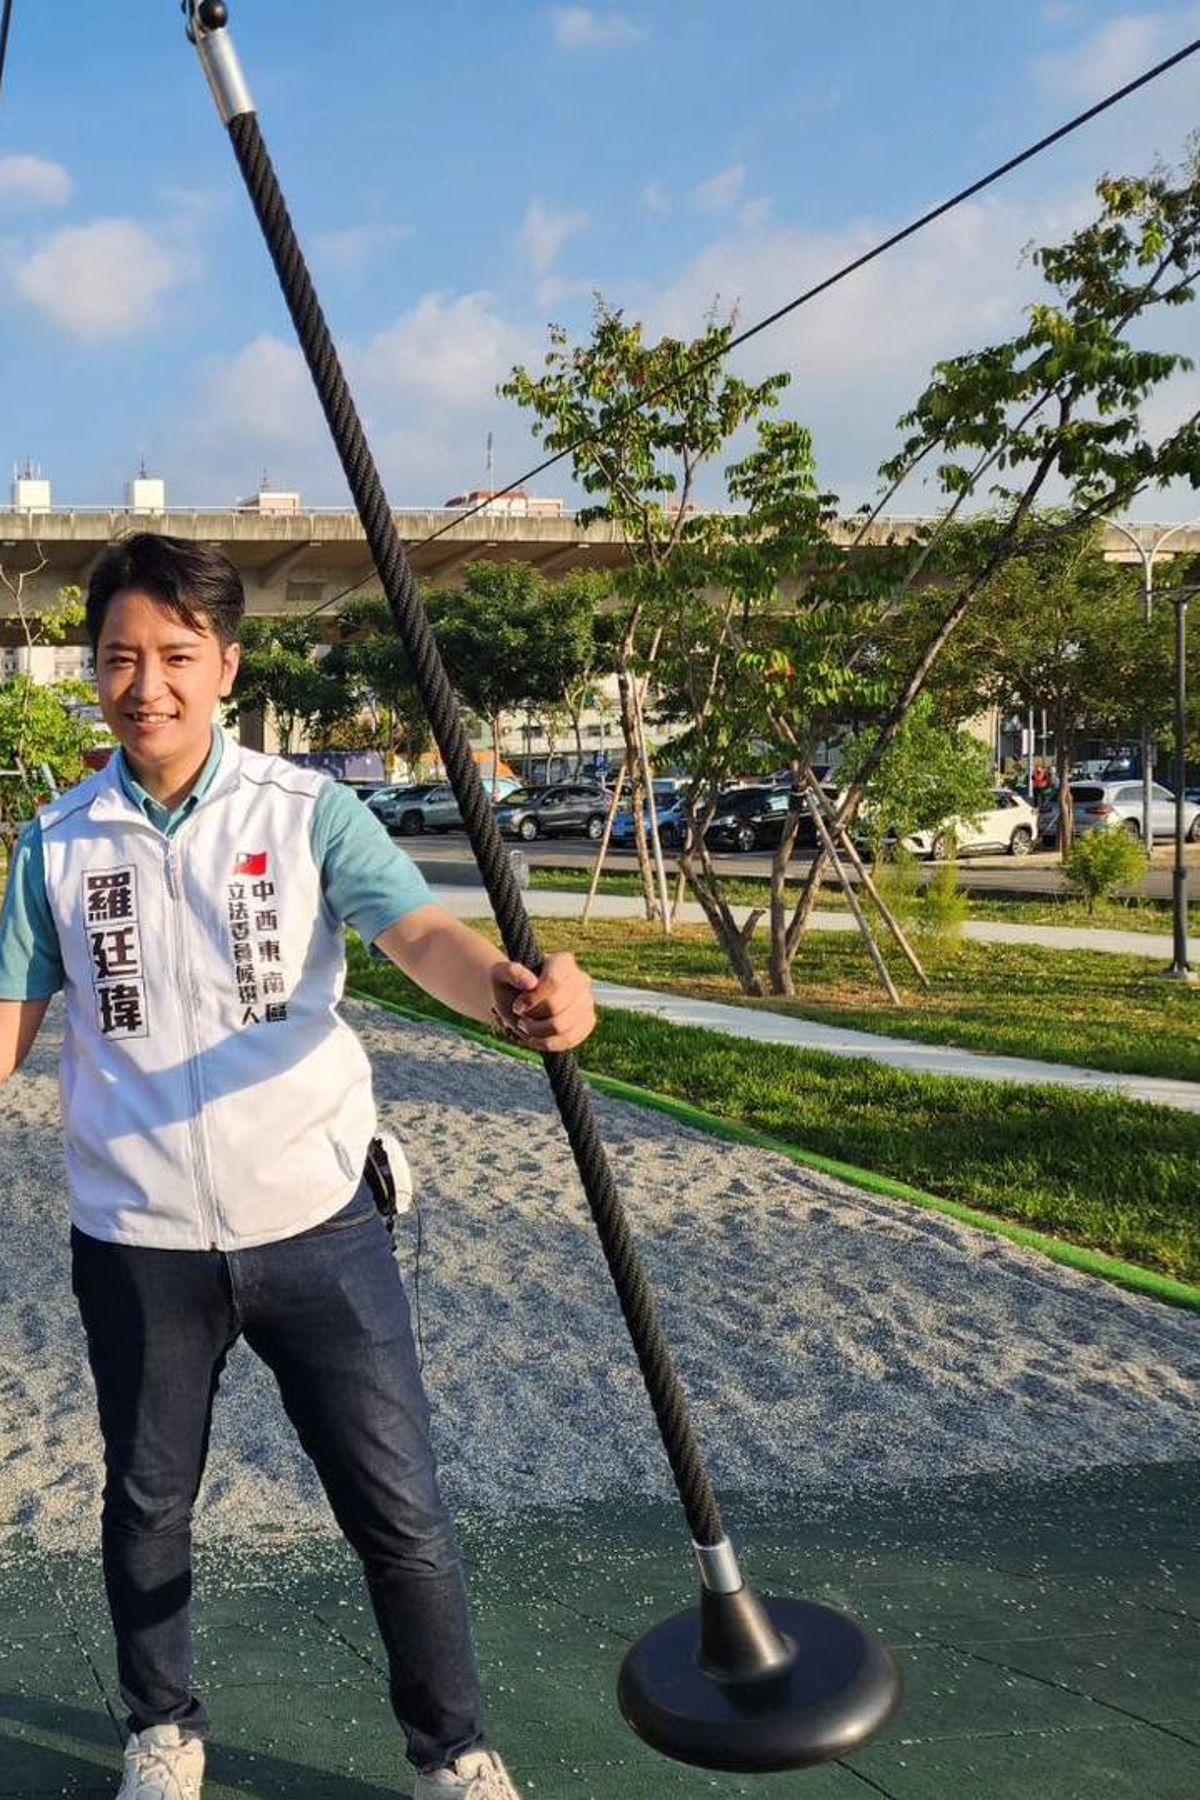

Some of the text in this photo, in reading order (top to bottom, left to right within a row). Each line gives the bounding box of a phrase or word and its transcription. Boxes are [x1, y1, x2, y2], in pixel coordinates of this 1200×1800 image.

[88, 872, 142, 1034] 羅廷瑋
[228, 882, 260, 1026] 立法委員候選人
[252, 880, 288, 1023] 中西東南區
